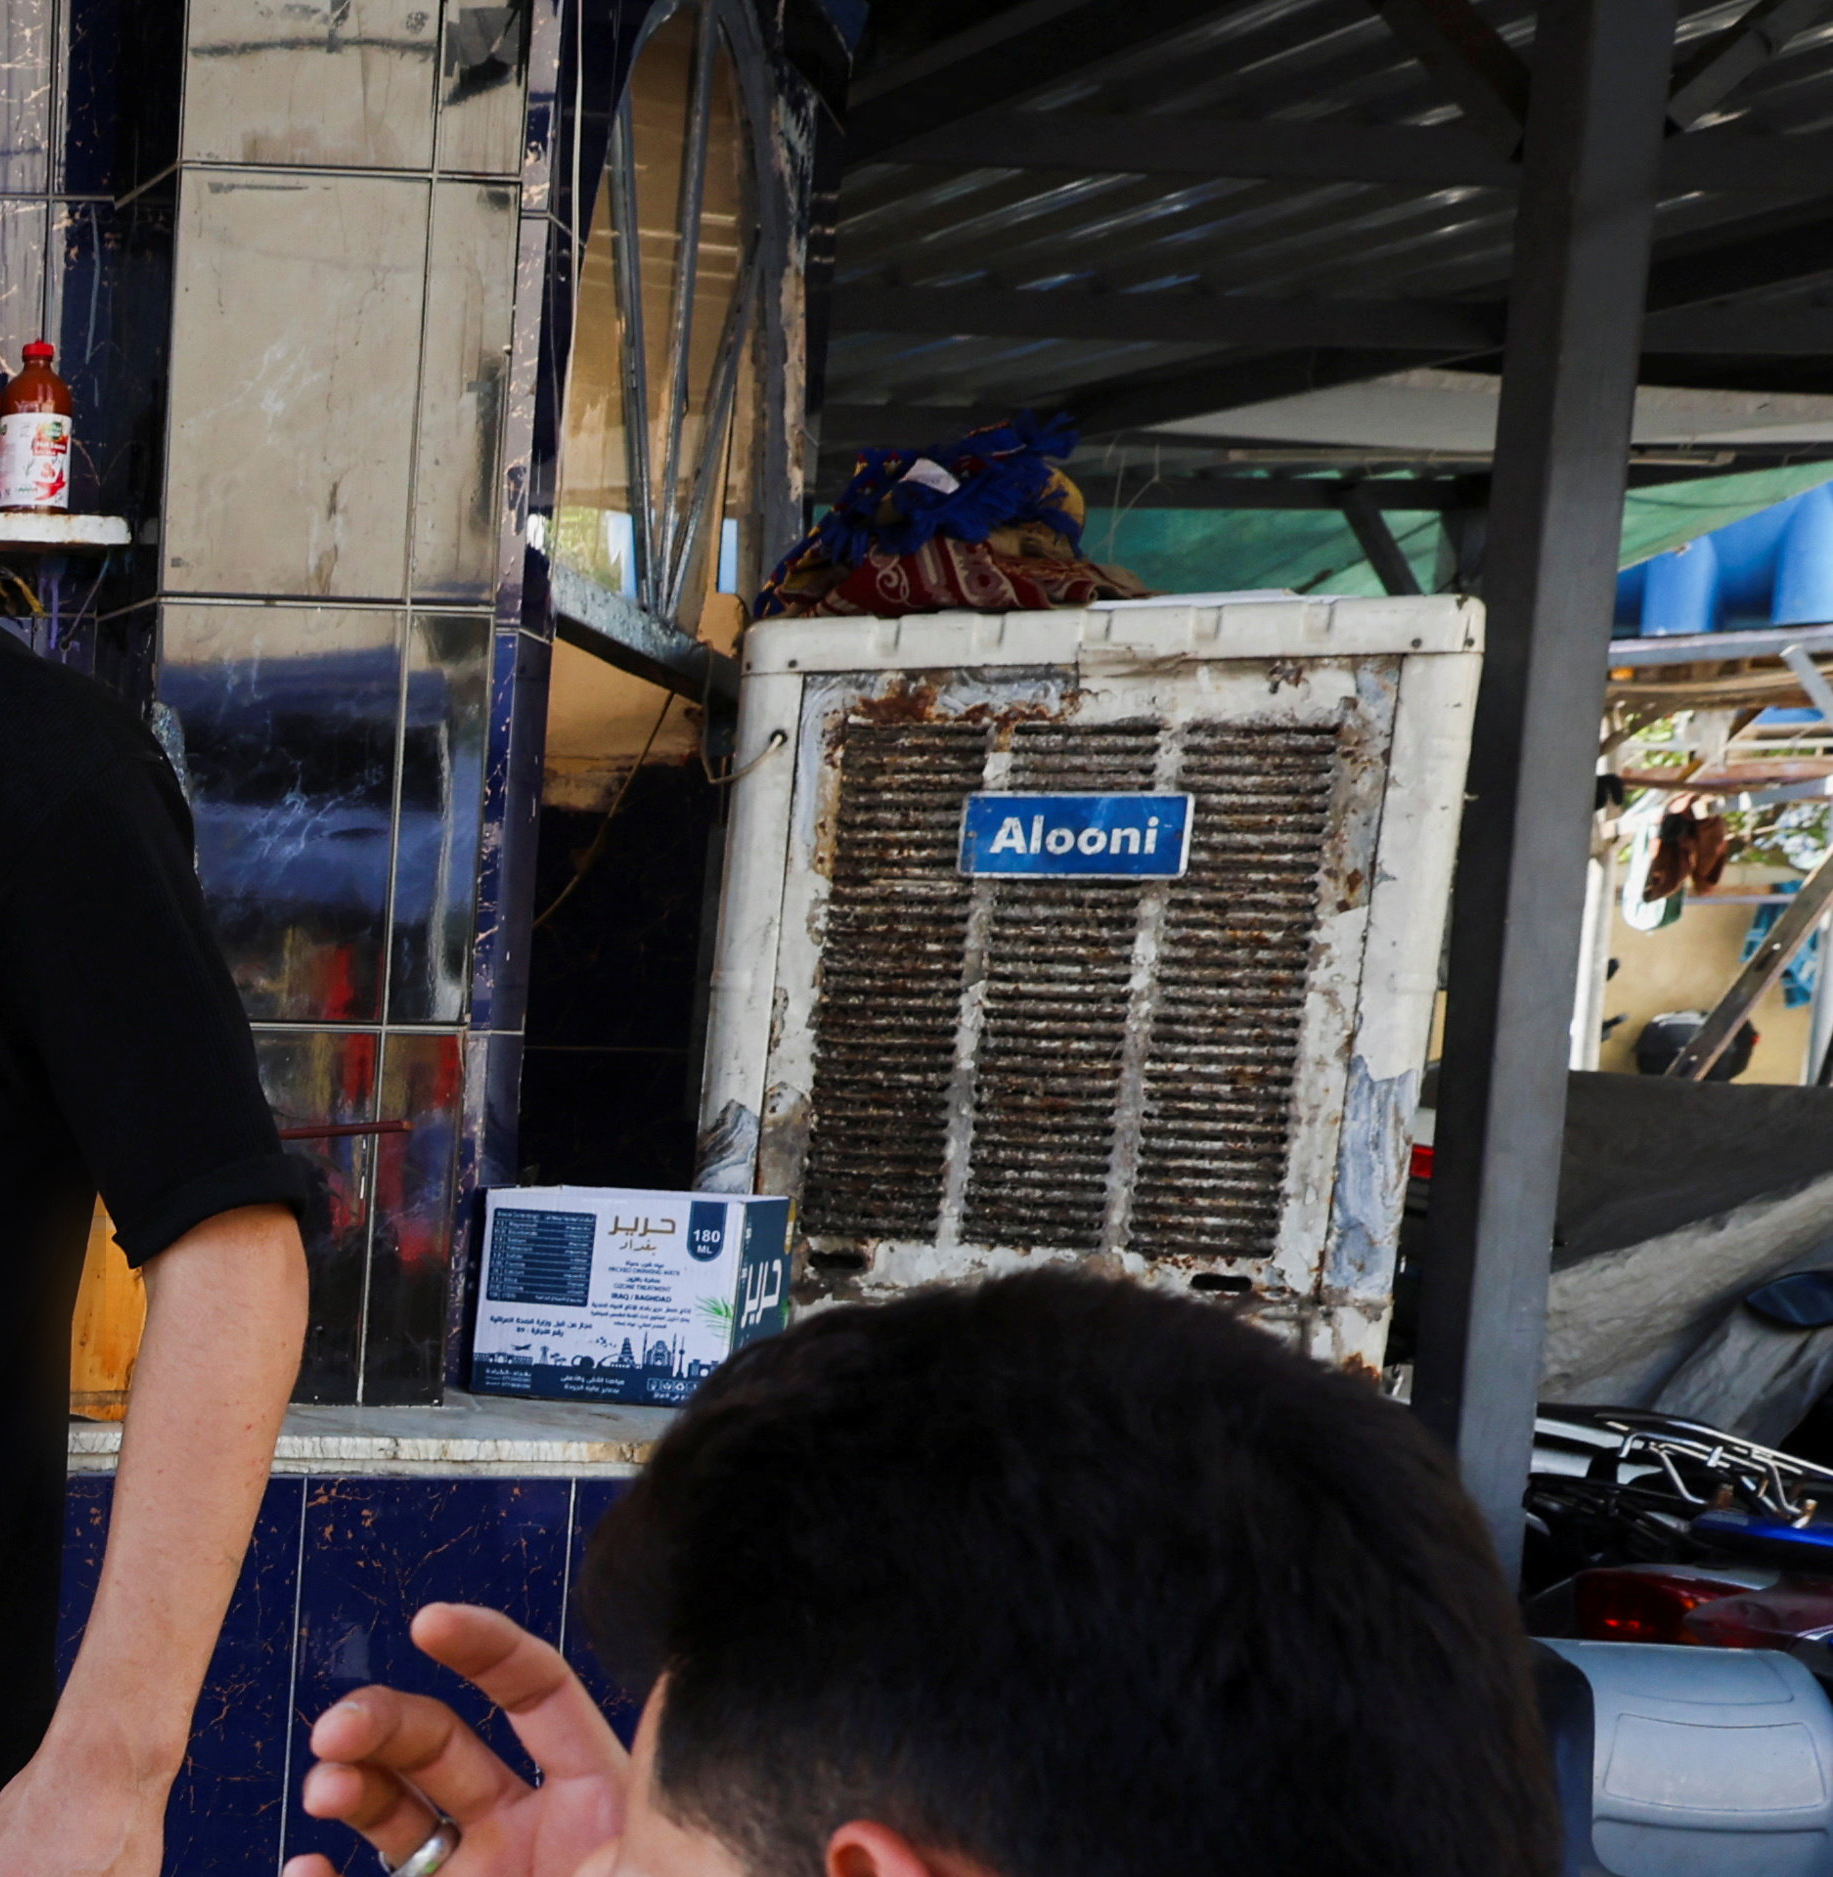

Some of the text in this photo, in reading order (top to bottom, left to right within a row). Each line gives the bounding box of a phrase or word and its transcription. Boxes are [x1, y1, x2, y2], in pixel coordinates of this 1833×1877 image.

[989, 815, 1159, 856] Alooni
[608, 1215, 677, 1238] حرير
[693, 1229, 721, 1243] 180
[697, 1245, 713, 1255] ML
[634, 1294, 672, 1303] BAGHDAD
